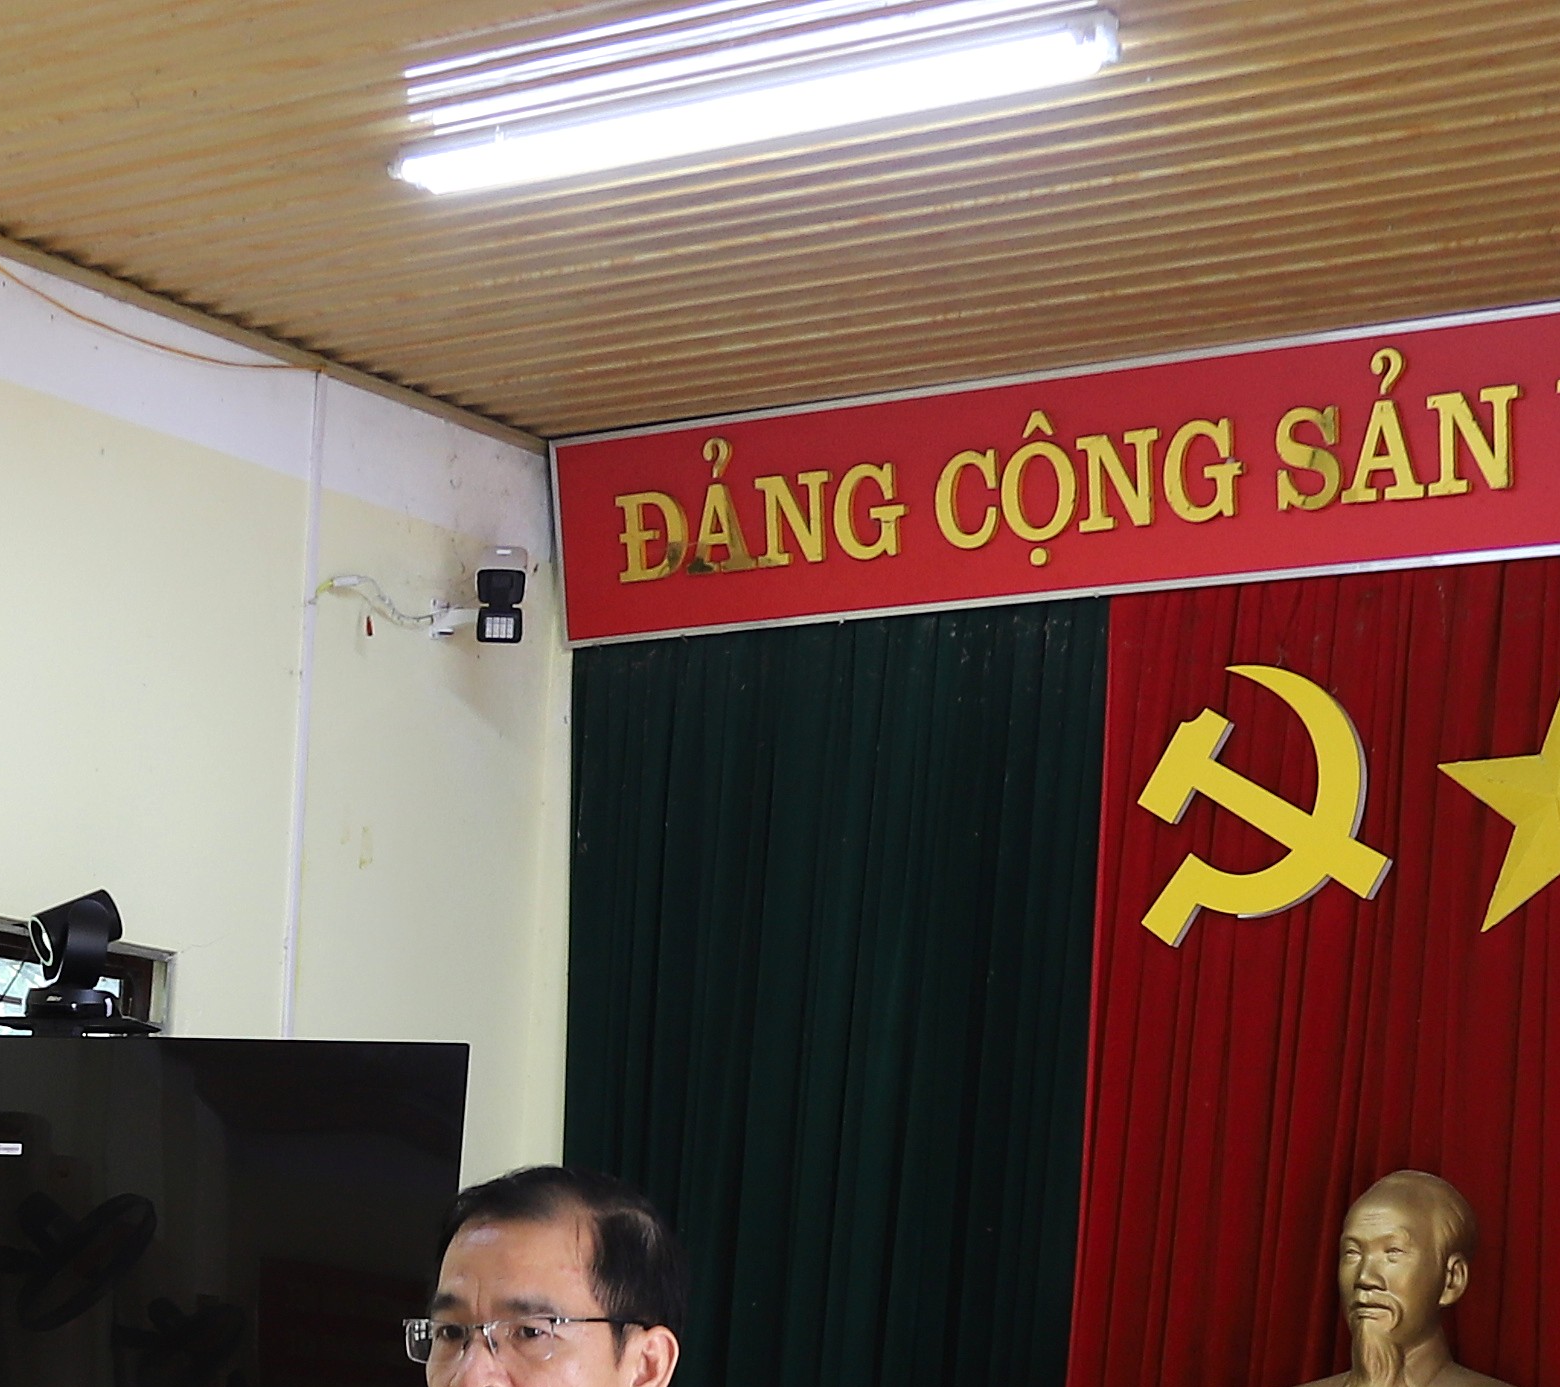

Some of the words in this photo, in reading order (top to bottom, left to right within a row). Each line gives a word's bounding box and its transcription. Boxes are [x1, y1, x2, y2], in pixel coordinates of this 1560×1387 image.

[615, 436, 908, 584] ĐẢNG
[934, 410, 1246, 567] CỘNG
[1274, 347, 1522, 511] SẢN
